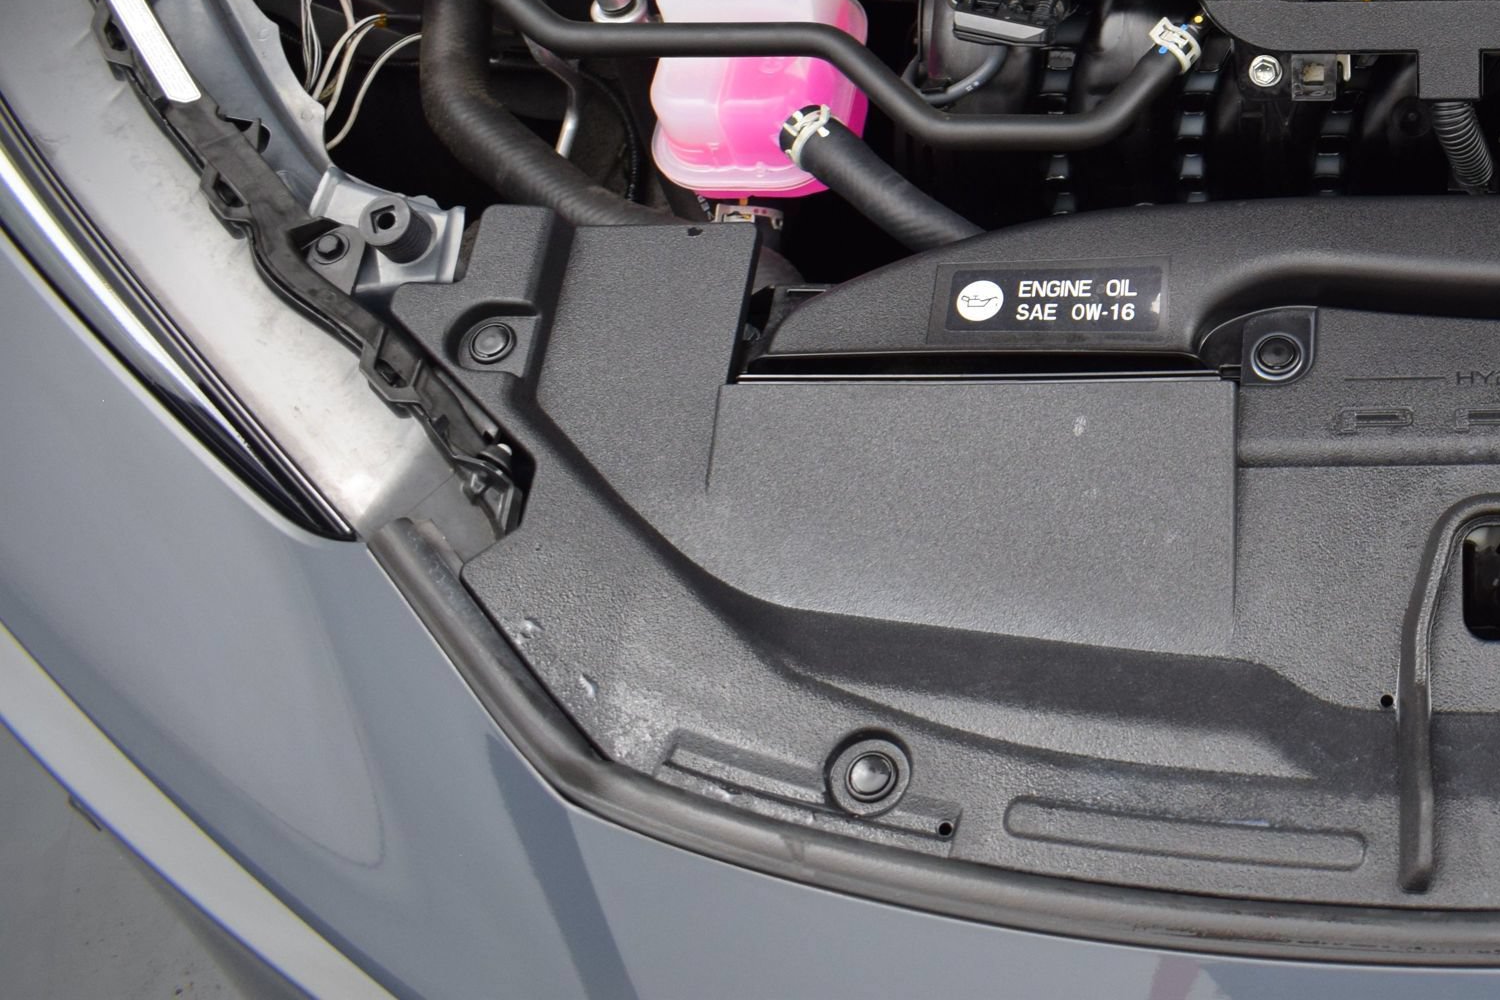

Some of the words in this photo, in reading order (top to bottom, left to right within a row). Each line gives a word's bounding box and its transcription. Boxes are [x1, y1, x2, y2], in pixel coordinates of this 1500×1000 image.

[1018, 280, 1092, 298] ENGINE
[1105, 279, 1137, 297] OIL
[1016, 303, 1058, 321] SAE
[1071, 303, 1135, 321] 0W-16
